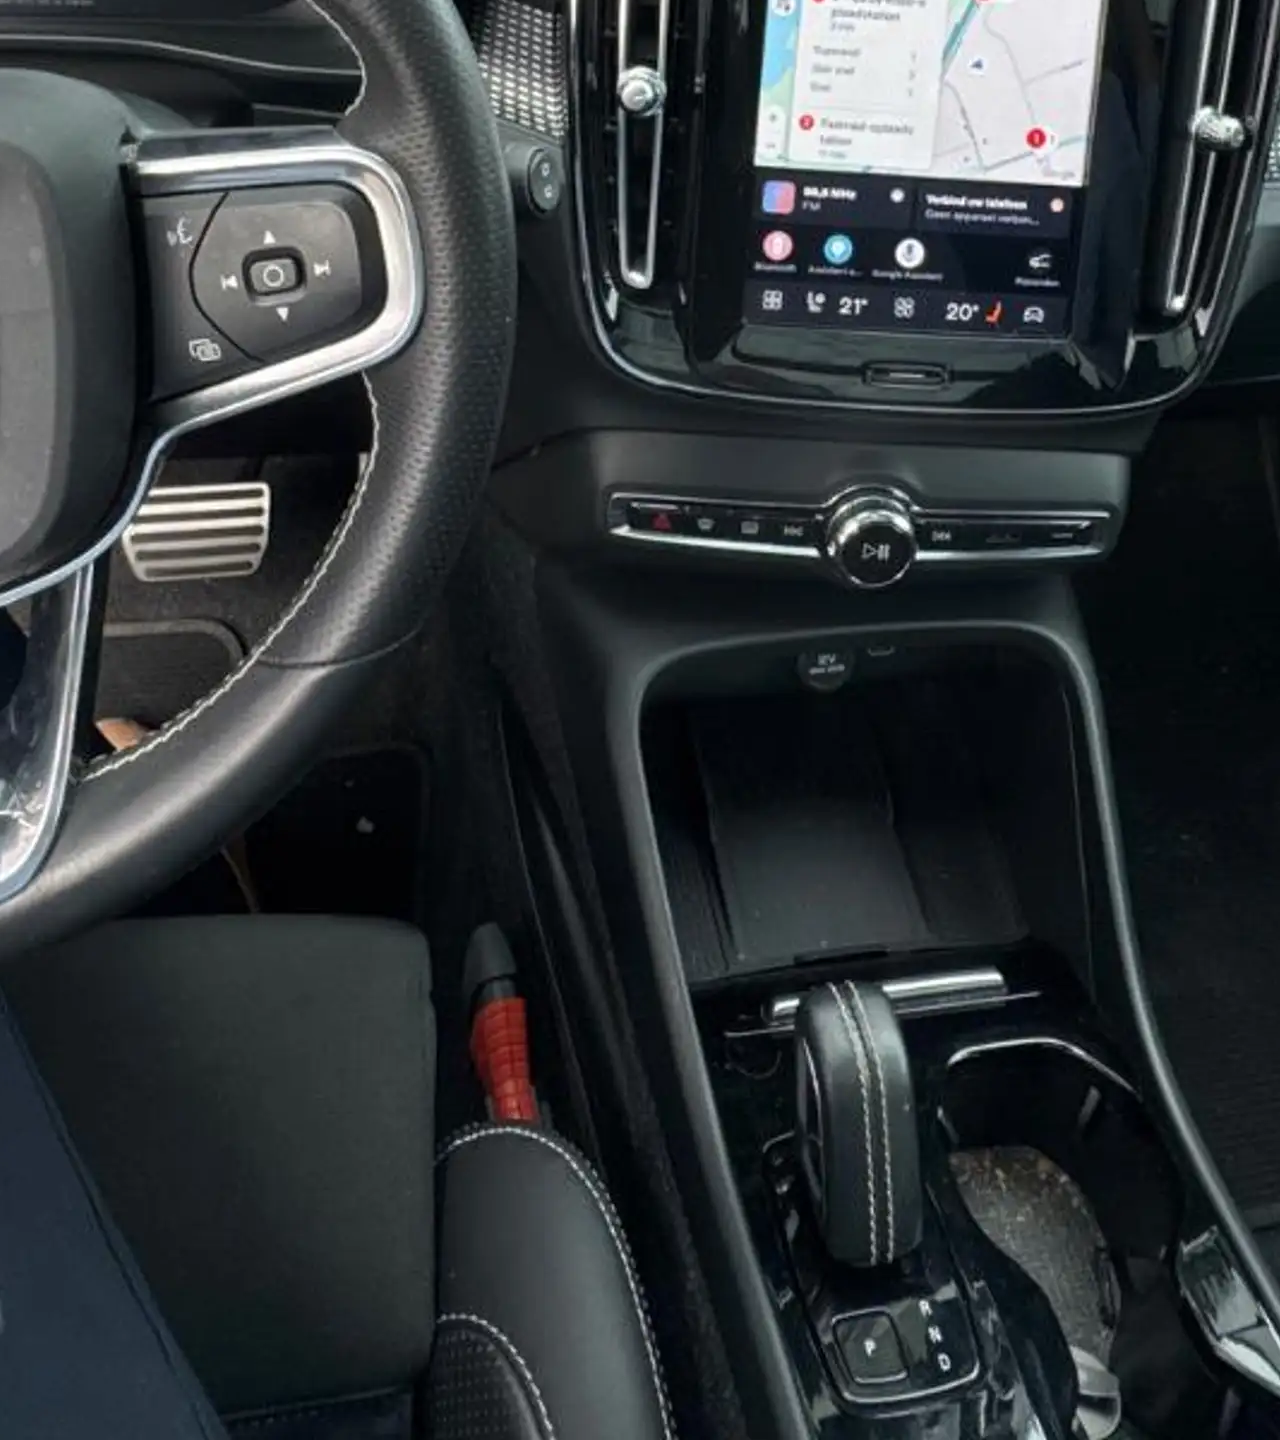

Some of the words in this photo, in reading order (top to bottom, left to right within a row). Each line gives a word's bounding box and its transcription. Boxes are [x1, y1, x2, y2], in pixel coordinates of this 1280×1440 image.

[838, 296, 869, 315] 21°
[945, 302, 981, 322] 20°
[863, 1336, 877, 1357] P
[937, 1352, 952, 1372] D
